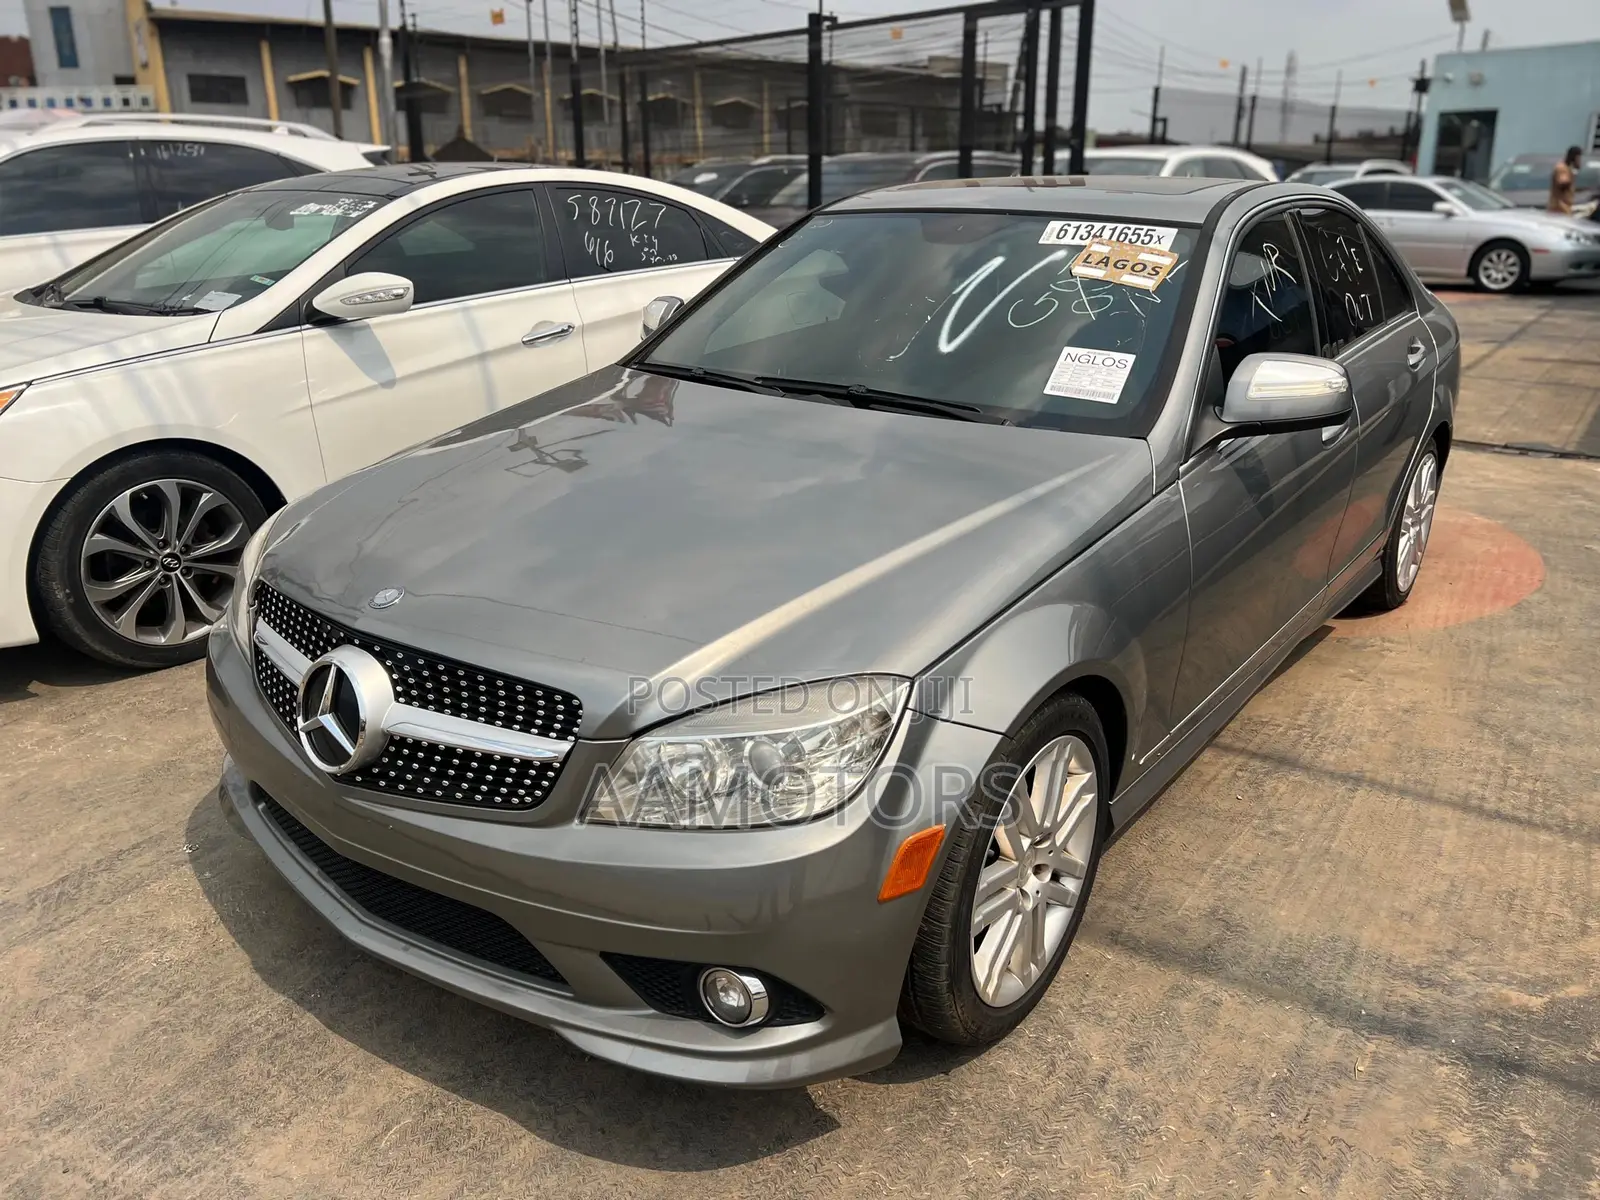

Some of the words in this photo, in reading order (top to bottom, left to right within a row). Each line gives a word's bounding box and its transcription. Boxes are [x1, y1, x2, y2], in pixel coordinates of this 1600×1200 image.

[567, 194, 667, 232] 587127
[1081, 253, 1163, 277] LAGOS
[1063, 352, 1129, 370] NGLOS
